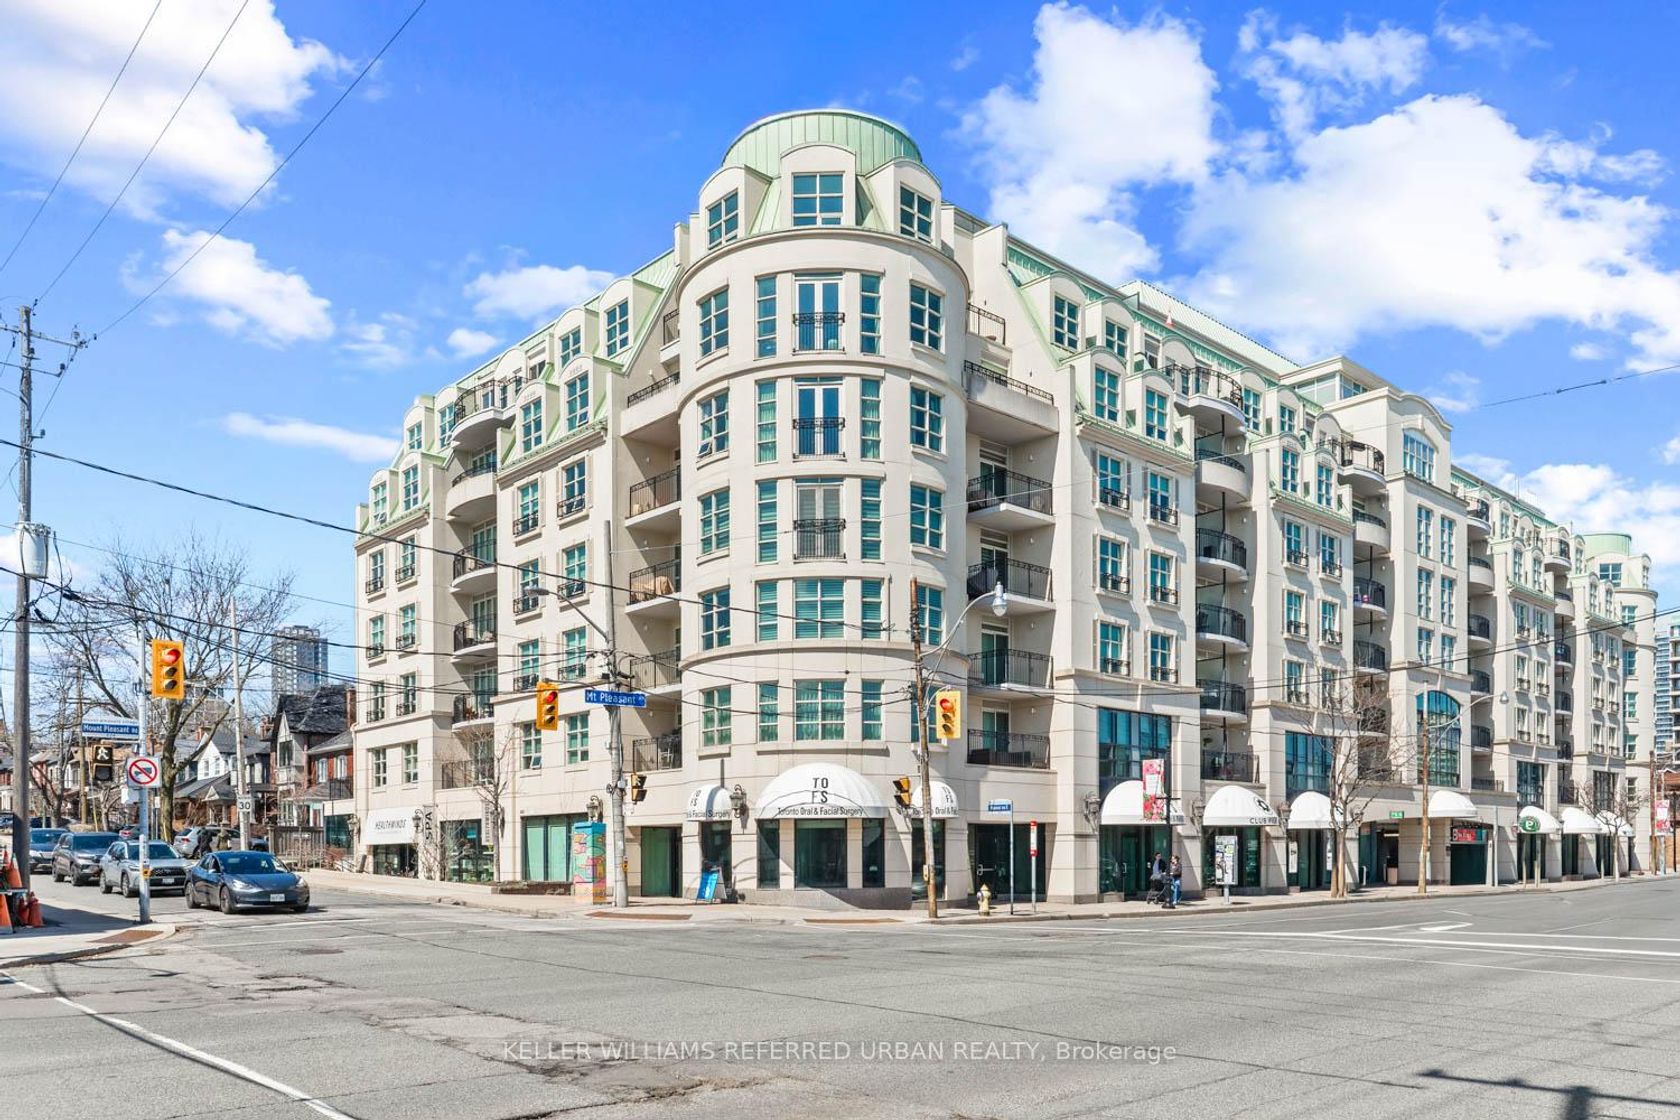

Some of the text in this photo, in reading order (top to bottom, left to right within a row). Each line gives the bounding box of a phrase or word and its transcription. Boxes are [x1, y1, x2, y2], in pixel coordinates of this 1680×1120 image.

[586, 692, 597, 702] Mt
[600, 692, 636, 704] Pleasant
[83, 724, 103, 732] Mount
[103, 725, 130, 733] Pleasant
[239, 801, 250, 810] 30
[777, 806, 864, 816] Toronto Oral & Facial Surgery
[1249, 817, 1267, 825] CLUB
[424, 812, 433, 840] SPA
